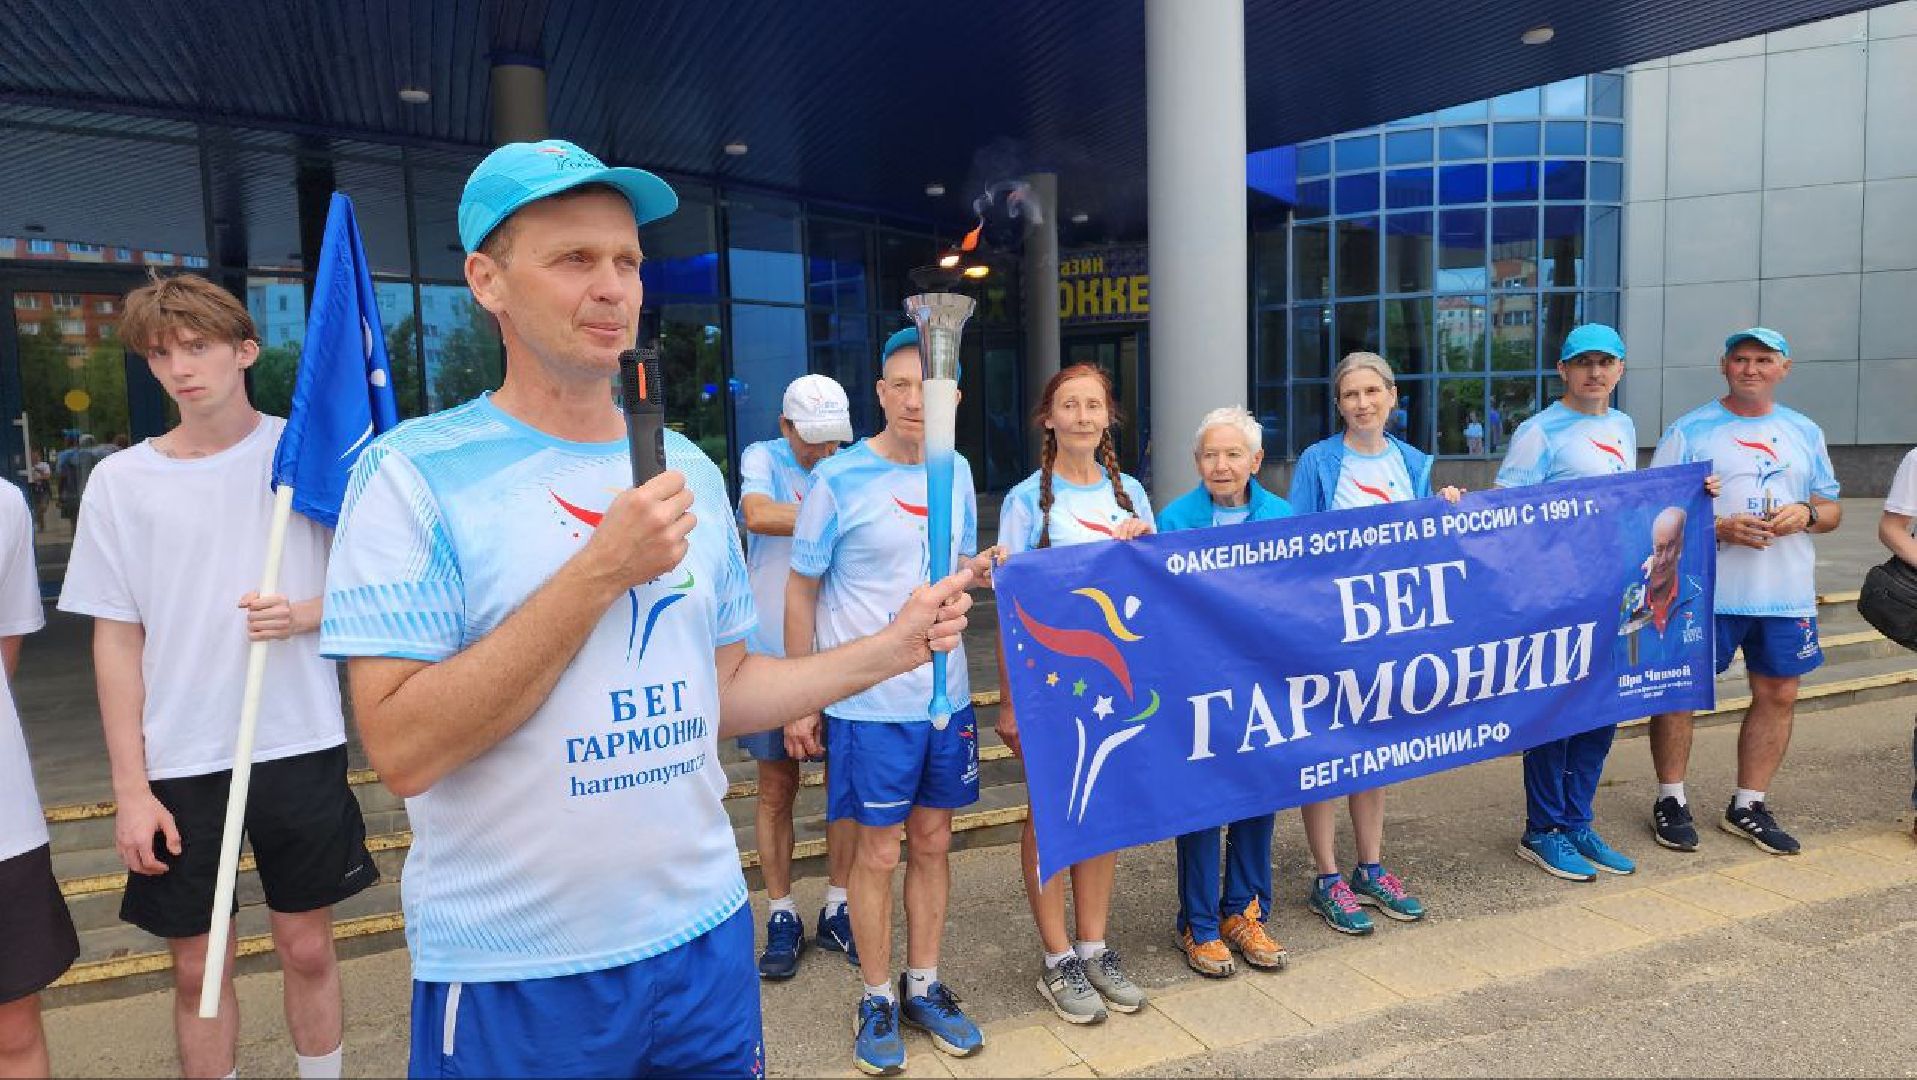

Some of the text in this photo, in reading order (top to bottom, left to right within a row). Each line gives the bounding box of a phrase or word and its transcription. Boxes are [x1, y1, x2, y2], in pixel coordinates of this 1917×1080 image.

[1166, 497, 1601, 576] ФАКЕЛЬНАЯ ЭСТАФЕТА В РОССИИ С 1991 г.
[1332, 560, 1468, 643] БЕГ
[608, 680, 688, 724] БЕГ
[1186, 621, 1598, 761] ГАРМОНИИ
[1299, 721, 1512, 791] БЕГ-ГАРМОНИИ.РФ
